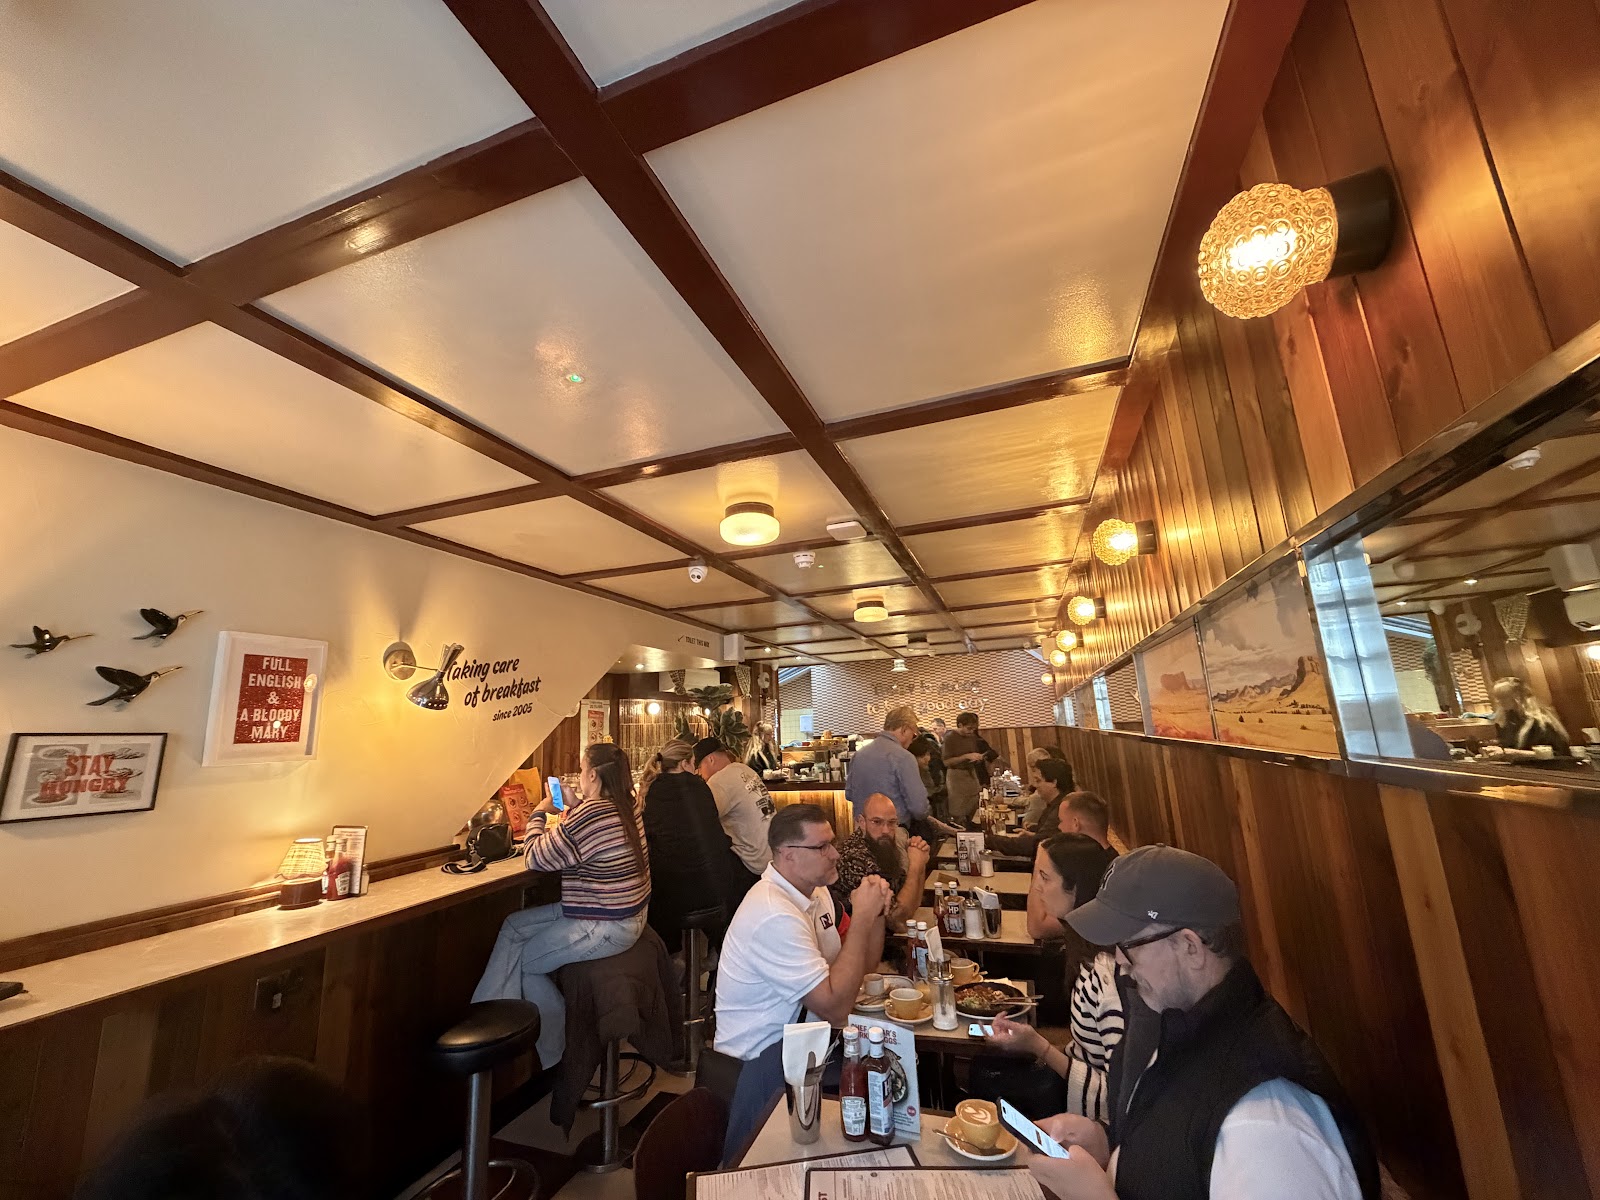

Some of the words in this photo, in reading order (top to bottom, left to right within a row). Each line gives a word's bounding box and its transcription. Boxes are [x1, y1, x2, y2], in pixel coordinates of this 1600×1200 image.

[262, 657, 293, 671] FULL
[446, 659, 490, 682] Taking
[492, 659, 520, 674] care
[248, 673, 302, 689] ENGLISH
[267, 691, 281, 705] &
[464, 685, 480, 708] of
[482, 677, 541, 702] breakfast
[239, 708, 249, 722] A
[252, 708, 301, 722] BLOODY
[492, 710, 512, 721] since
[513, 703, 533, 717] 2005
[250, 725, 289, 739] MARY
[64, 754, 116, 776] STAY
[40, 775, 130, 799] HUNGRY
[960, 852, 969, 860] HP
[948, 905, 960, 915] HP
